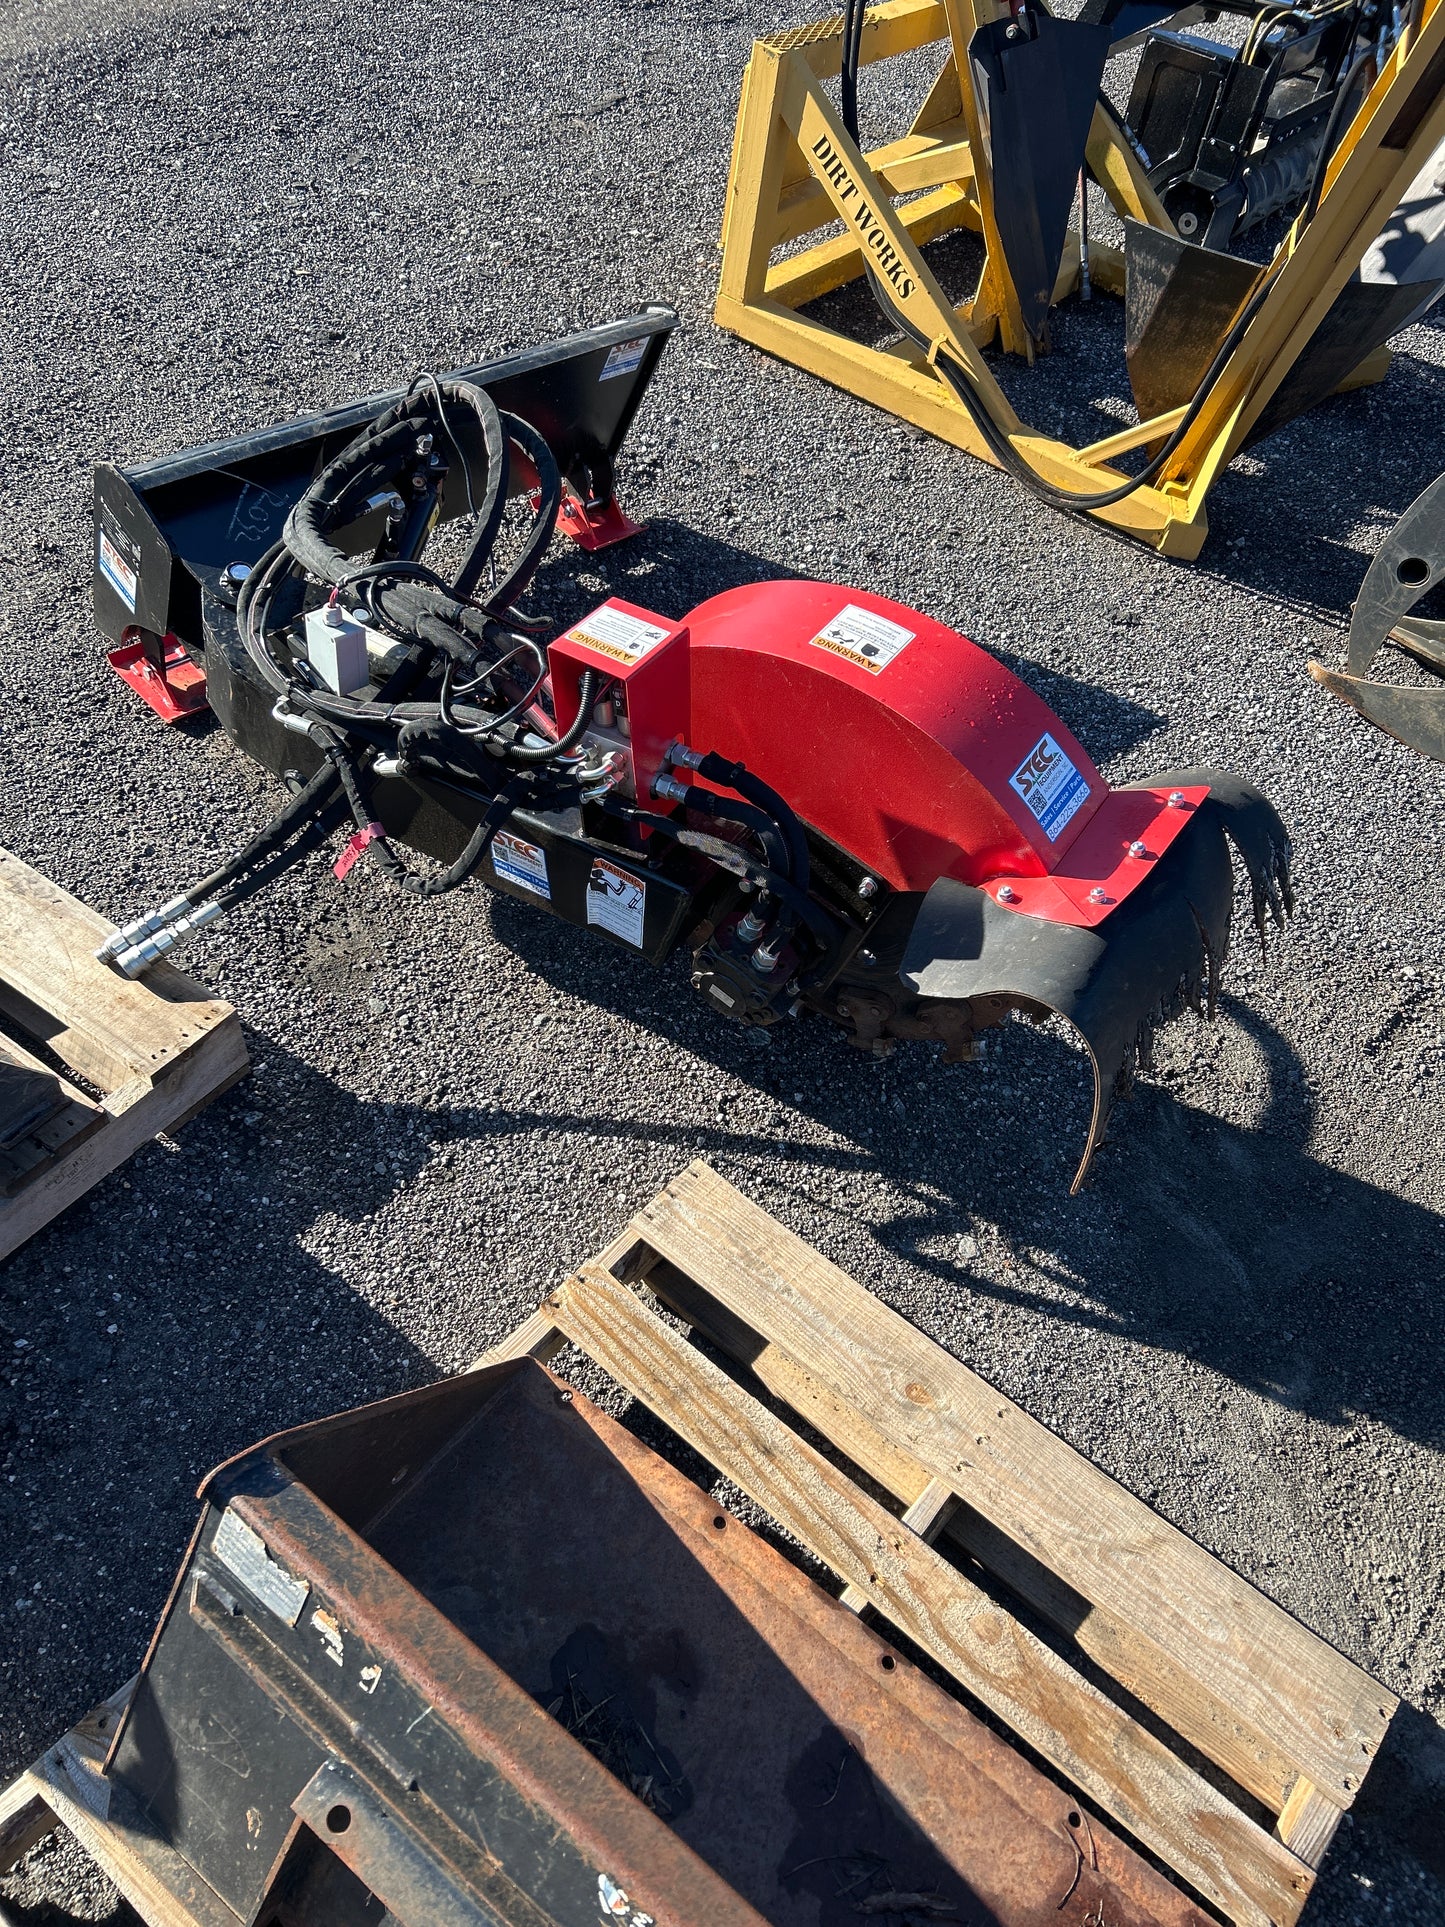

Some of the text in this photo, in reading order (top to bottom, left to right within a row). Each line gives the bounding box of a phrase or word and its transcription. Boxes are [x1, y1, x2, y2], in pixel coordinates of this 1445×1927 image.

[811, 134, 916, 299] DIRT WORKS
[575, 634, 622, 657] WARNING
[817, 639, 867, 664] WARNING
[1016, 739, 1053, 797] STEC
[1038, 753, 1063, 787] EQUIPMENT
[1040, 811, 1052, 828] Sales
[1053, 789, 1069, 811] Service
[1069, 773, 1081, 789] Parts
[1047, 783, 1089, 840] 864-225-3666
[493, 831, 539, 860] STEC
[600, 860, 642, 887] WARNING
